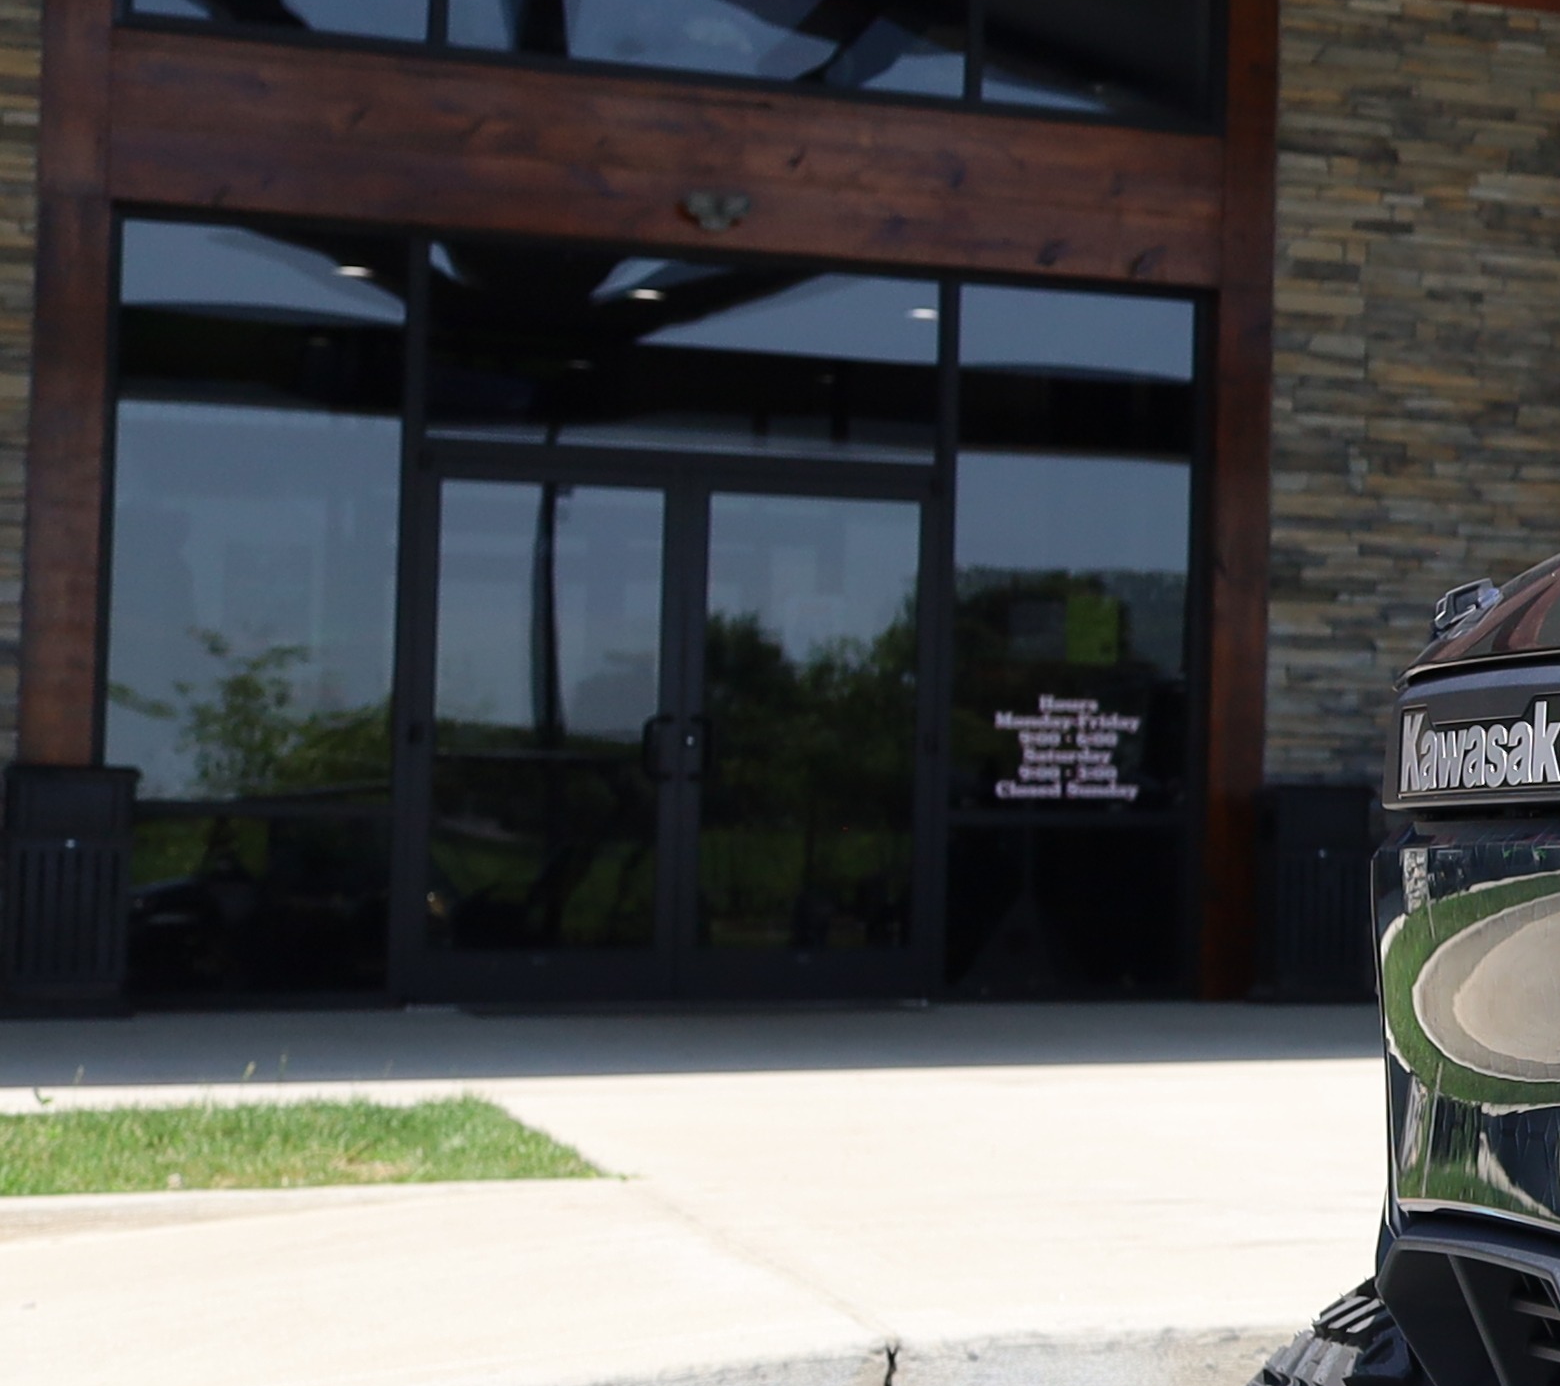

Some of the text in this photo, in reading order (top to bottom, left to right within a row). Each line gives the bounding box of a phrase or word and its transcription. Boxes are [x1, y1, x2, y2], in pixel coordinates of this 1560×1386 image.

[1039, 694, 1098, 713] Hours
[1024, 747, 1112, 764] Saturday
[995, 780, 1138, 801] Closed Sunday
